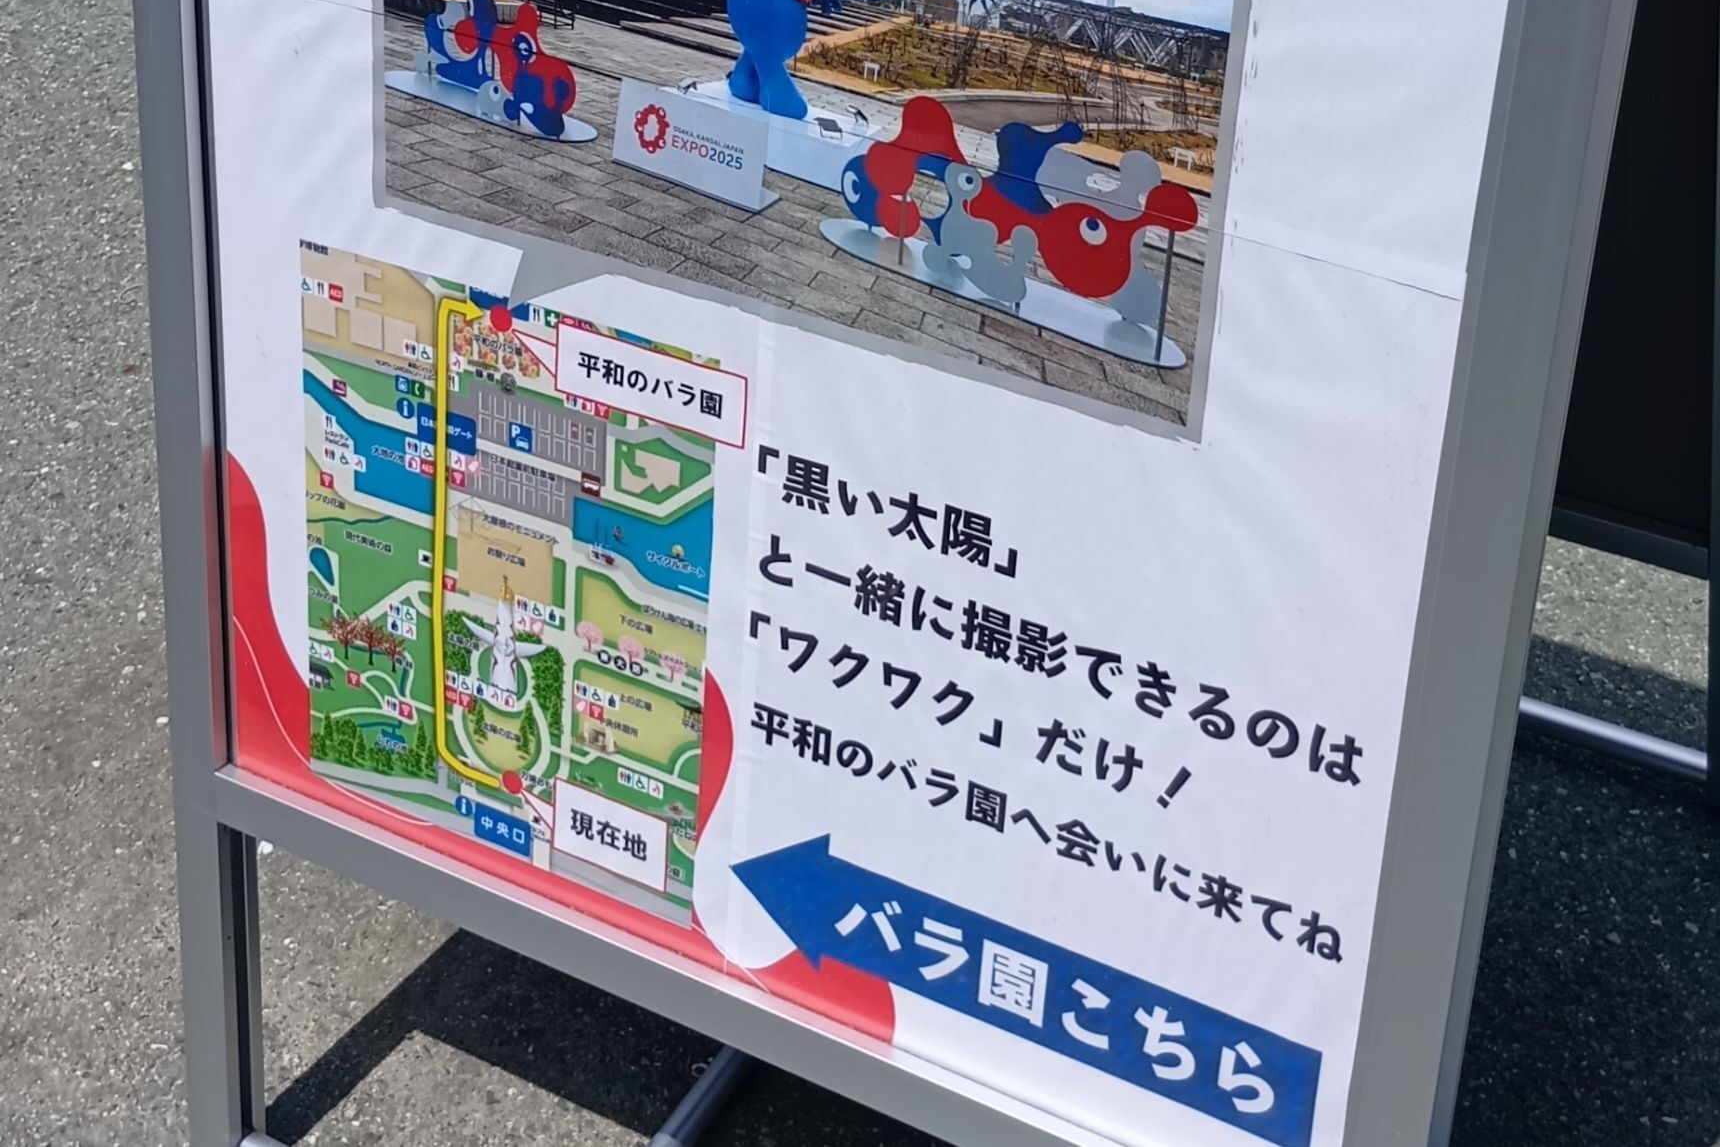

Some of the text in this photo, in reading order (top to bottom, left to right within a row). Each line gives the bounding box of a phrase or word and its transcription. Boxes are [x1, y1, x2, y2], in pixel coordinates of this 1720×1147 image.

[671, 134, 743, 170] EXPO2025
[578, 351, 723, 419] 平和のバラ園
[758, 445, 1019, 578] 「黒い太陽」
[757, 534, 1364, 787] と一緒に撮影できるのは
[481, 815, 525, 844] 中央口
[570, 808, 648, 862] 現在地
[750, 702, 1344, 964] 平和のバラ園へ会いに来てね
[833, 901, 1277, 1114] バラ園こちら
